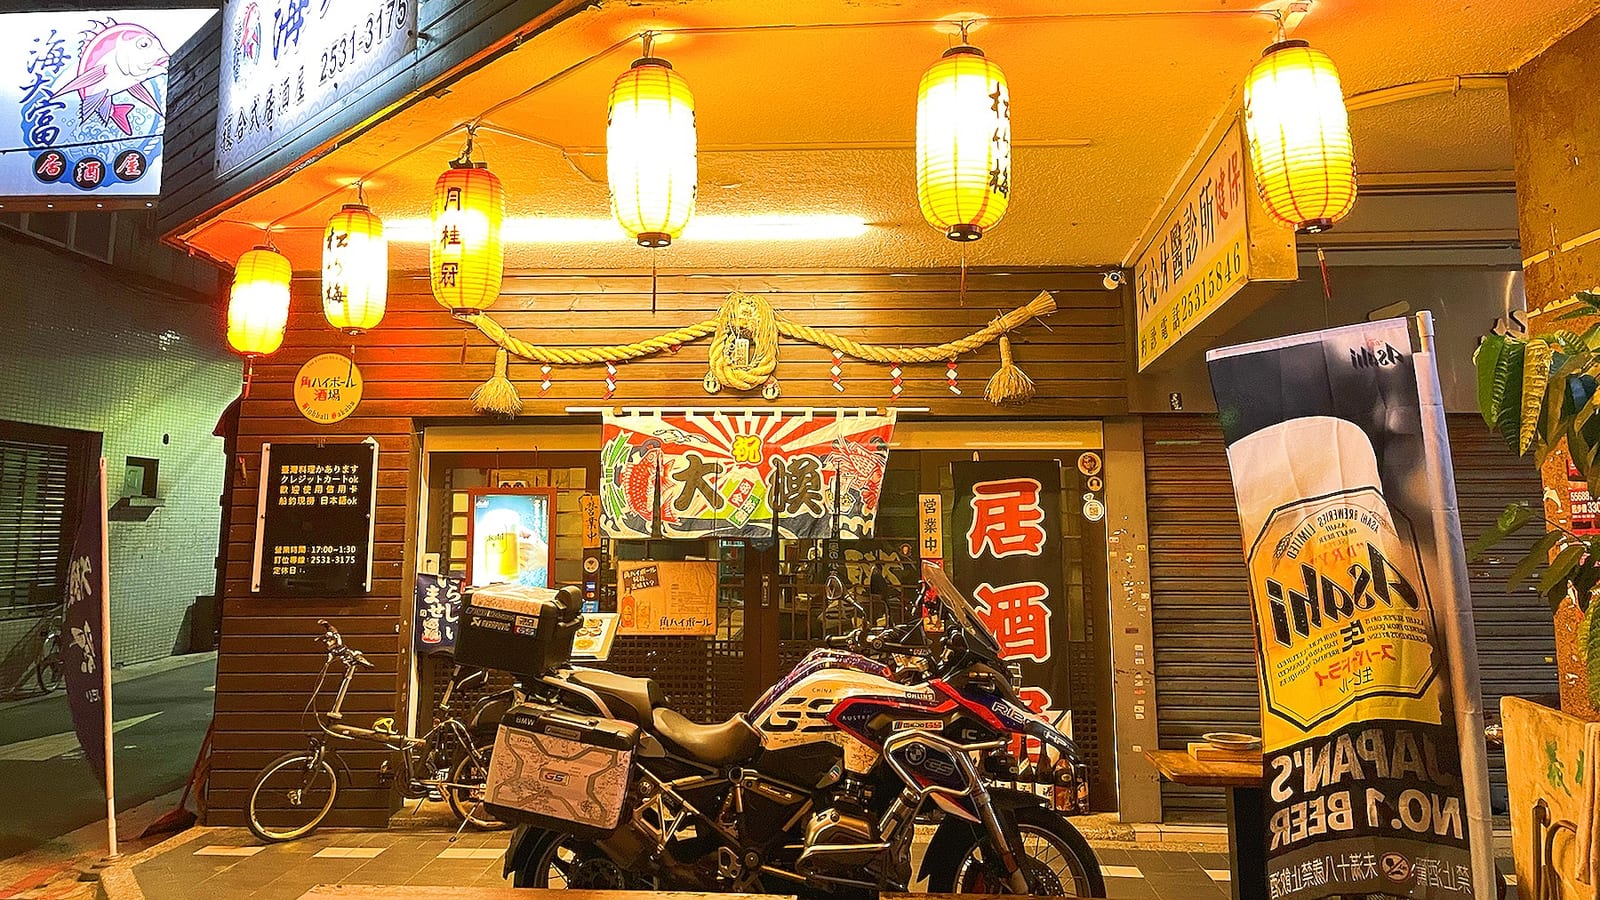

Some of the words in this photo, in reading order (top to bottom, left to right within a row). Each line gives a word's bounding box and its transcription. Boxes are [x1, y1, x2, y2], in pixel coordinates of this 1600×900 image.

[318, 0, 409, 85] 2531-3175
[18, 29, 73, 148] 海大富
[37, 150, 146, 184] 居酒屋
[1215, 151, 1242, 226] 健保
[440, 187, 463, 289] 月桂冠
[1181, 241, 1242, 322] 25315846
[300, 376, 358, 389] 角ハイボール
[313, 388, 341, 402] 酒場
[731, 434, 762, 464] 祝
[923, 498, 938, 552] 営業中
[659, 616, 713, 628] 角ハイボール
[515, 717, 536, 726] BMW
[544, 772, 564, 782] GS
